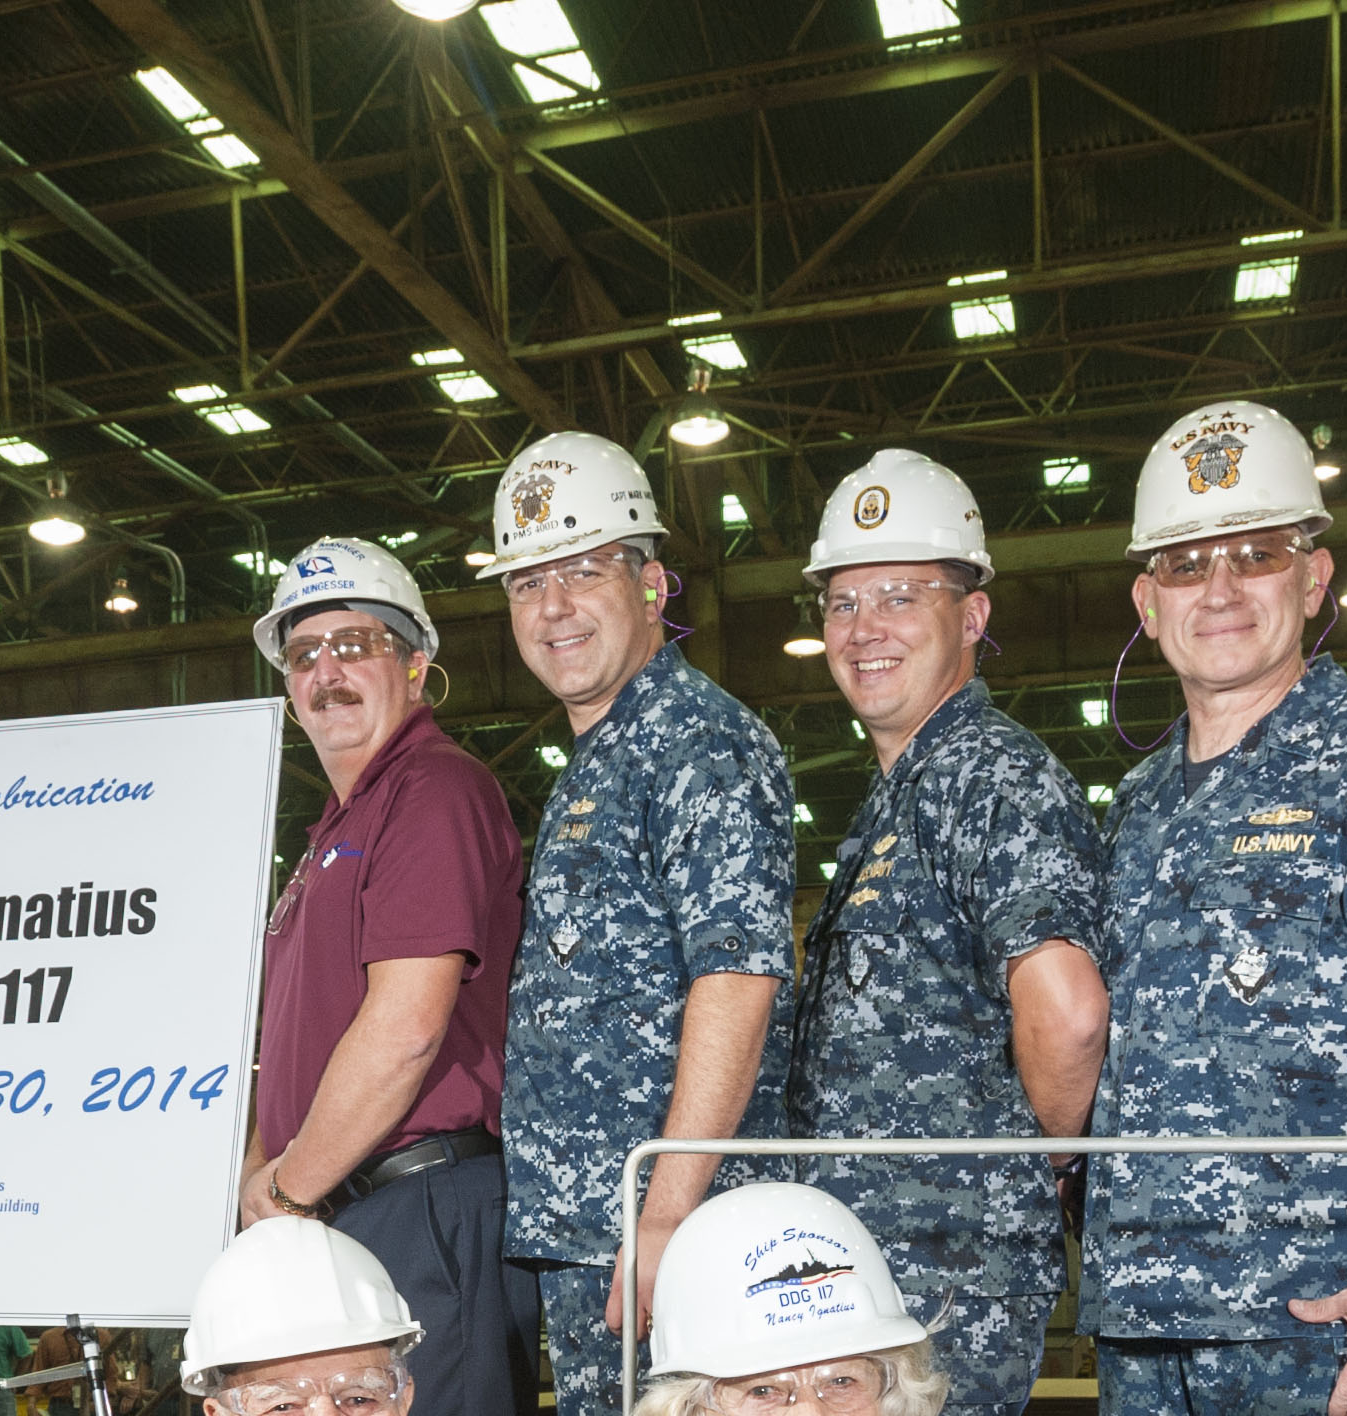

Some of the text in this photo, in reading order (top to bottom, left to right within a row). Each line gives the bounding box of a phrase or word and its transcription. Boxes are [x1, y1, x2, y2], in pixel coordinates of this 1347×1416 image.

[1201, 422, 1255, 436] NAVY
[528, 460, 579, 475] NAVY
[513, 529, 532, 541] PMS
[301, 580, 355, 596] NUNGESSER
[571, 823, 593, 840] NAVY
[1232, 833, 1317, 853] U.S. NAVY
[0, 966, 74, 1025] 117
[82, 1064, 230, 1113] 2014
[744, 1227, 849, 1272] Ship Sponsor
[779, 1284, 834, 1308] DDG 117
[764, 1302, 855, 1327] Nancy Ignatius
